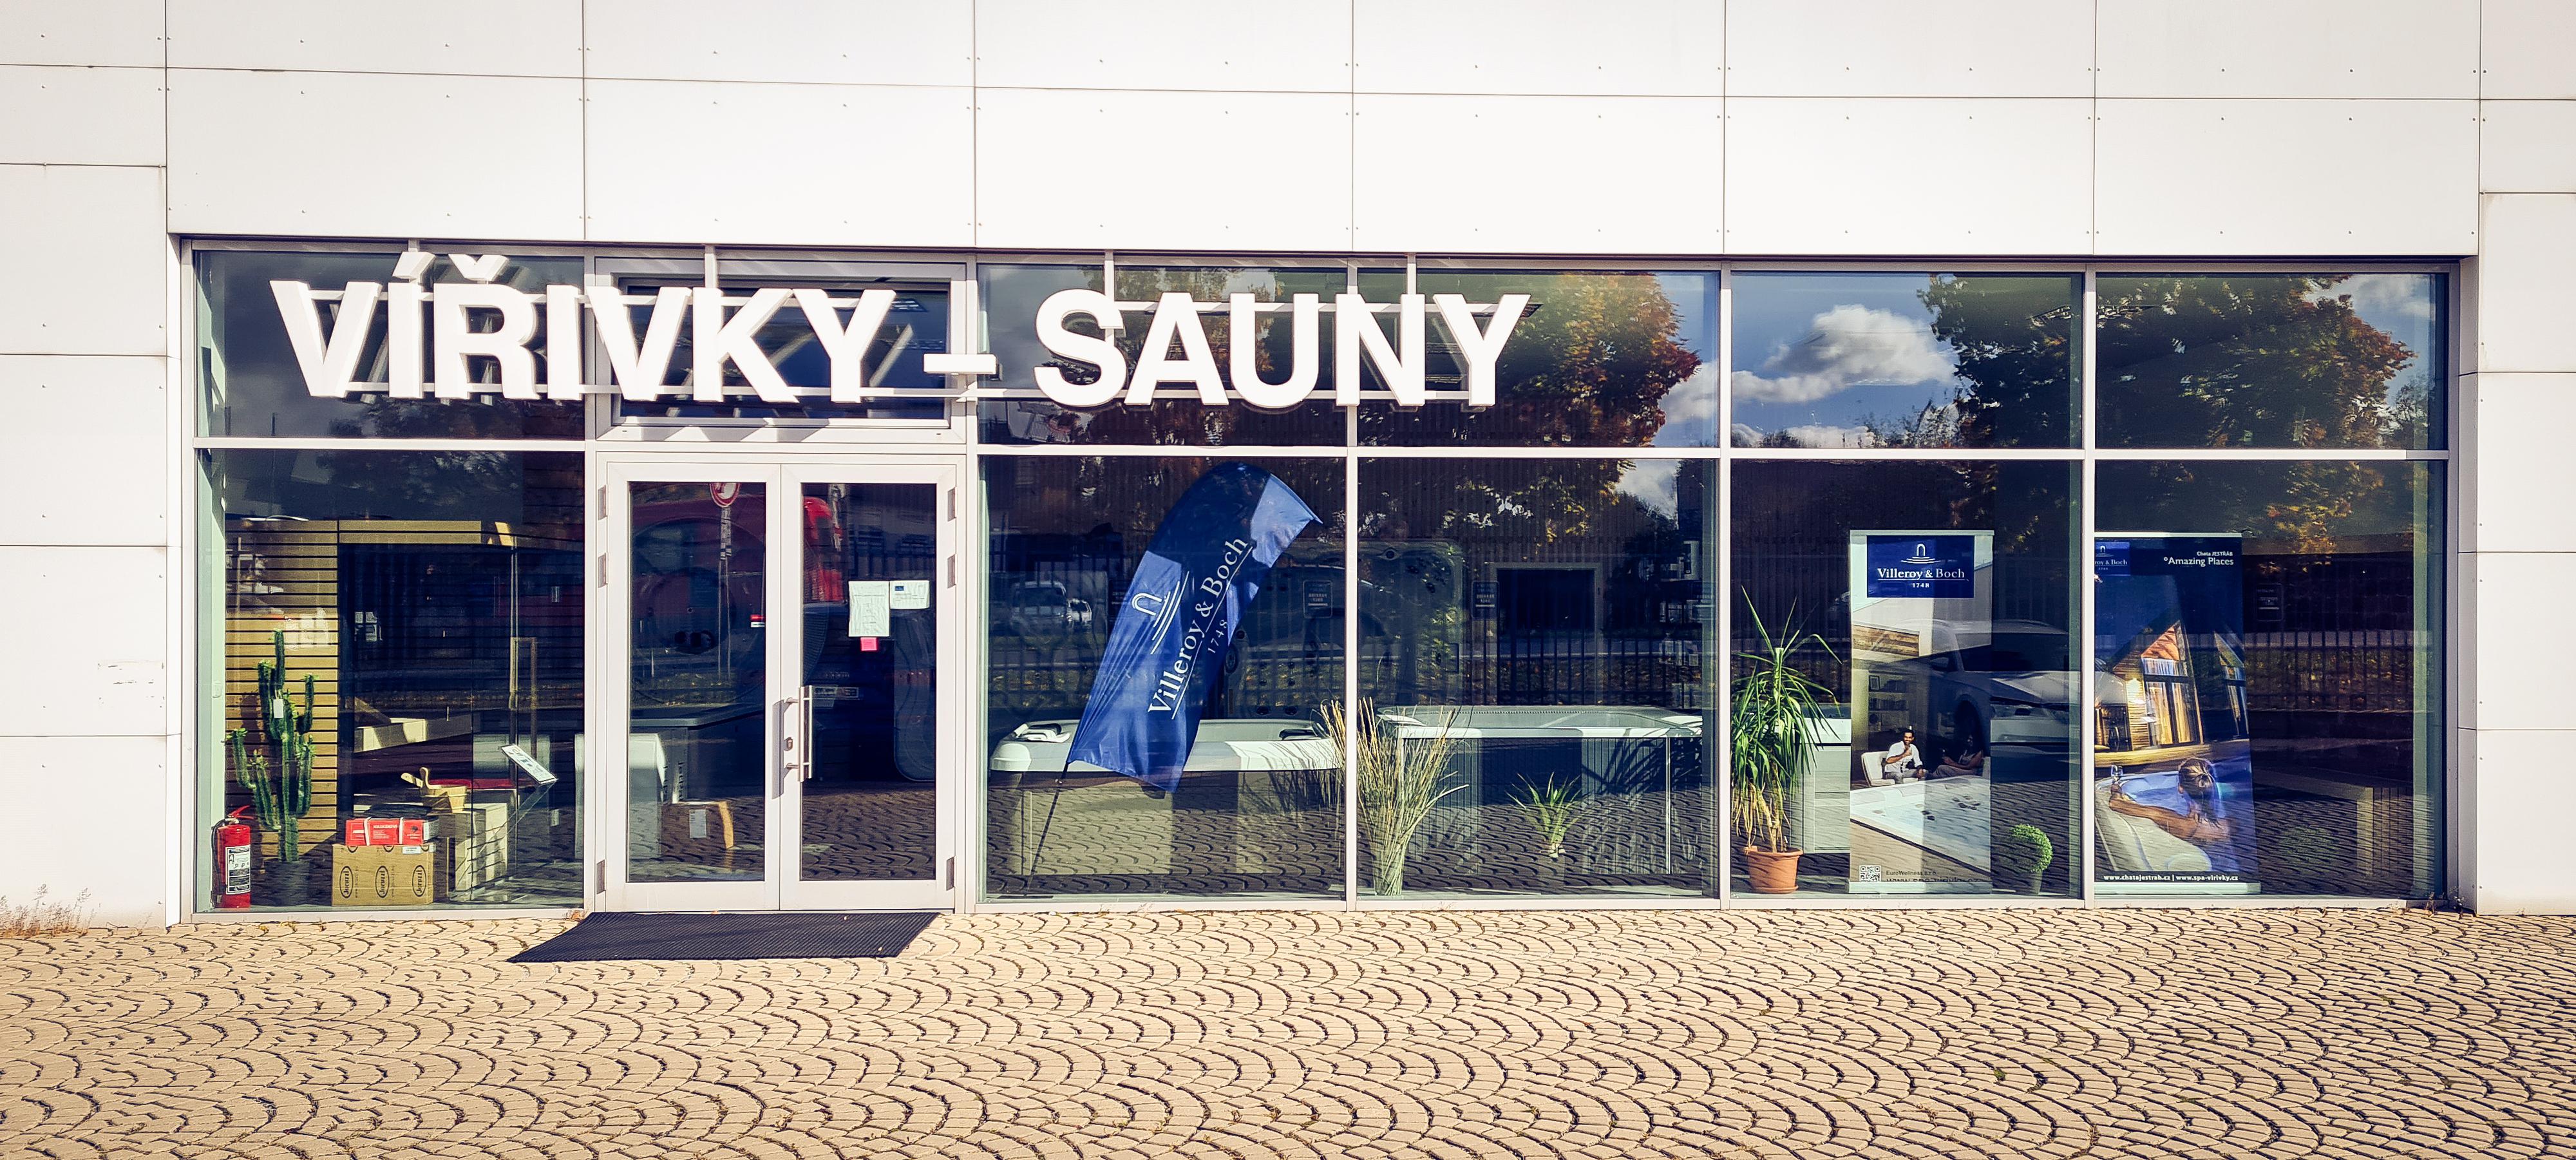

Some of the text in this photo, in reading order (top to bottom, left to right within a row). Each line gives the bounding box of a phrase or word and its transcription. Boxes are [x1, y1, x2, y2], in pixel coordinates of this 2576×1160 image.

[269, 251, 896, 403] VÍŘIVKY
[1034, 289, 1531, 408] SAUNY
[1877, 568, 1964, 580] Villeroy & Boch
[1148, 538, 1248, 712] Villeroy & Boch
[1208, 620, 1228, 653] 1748
